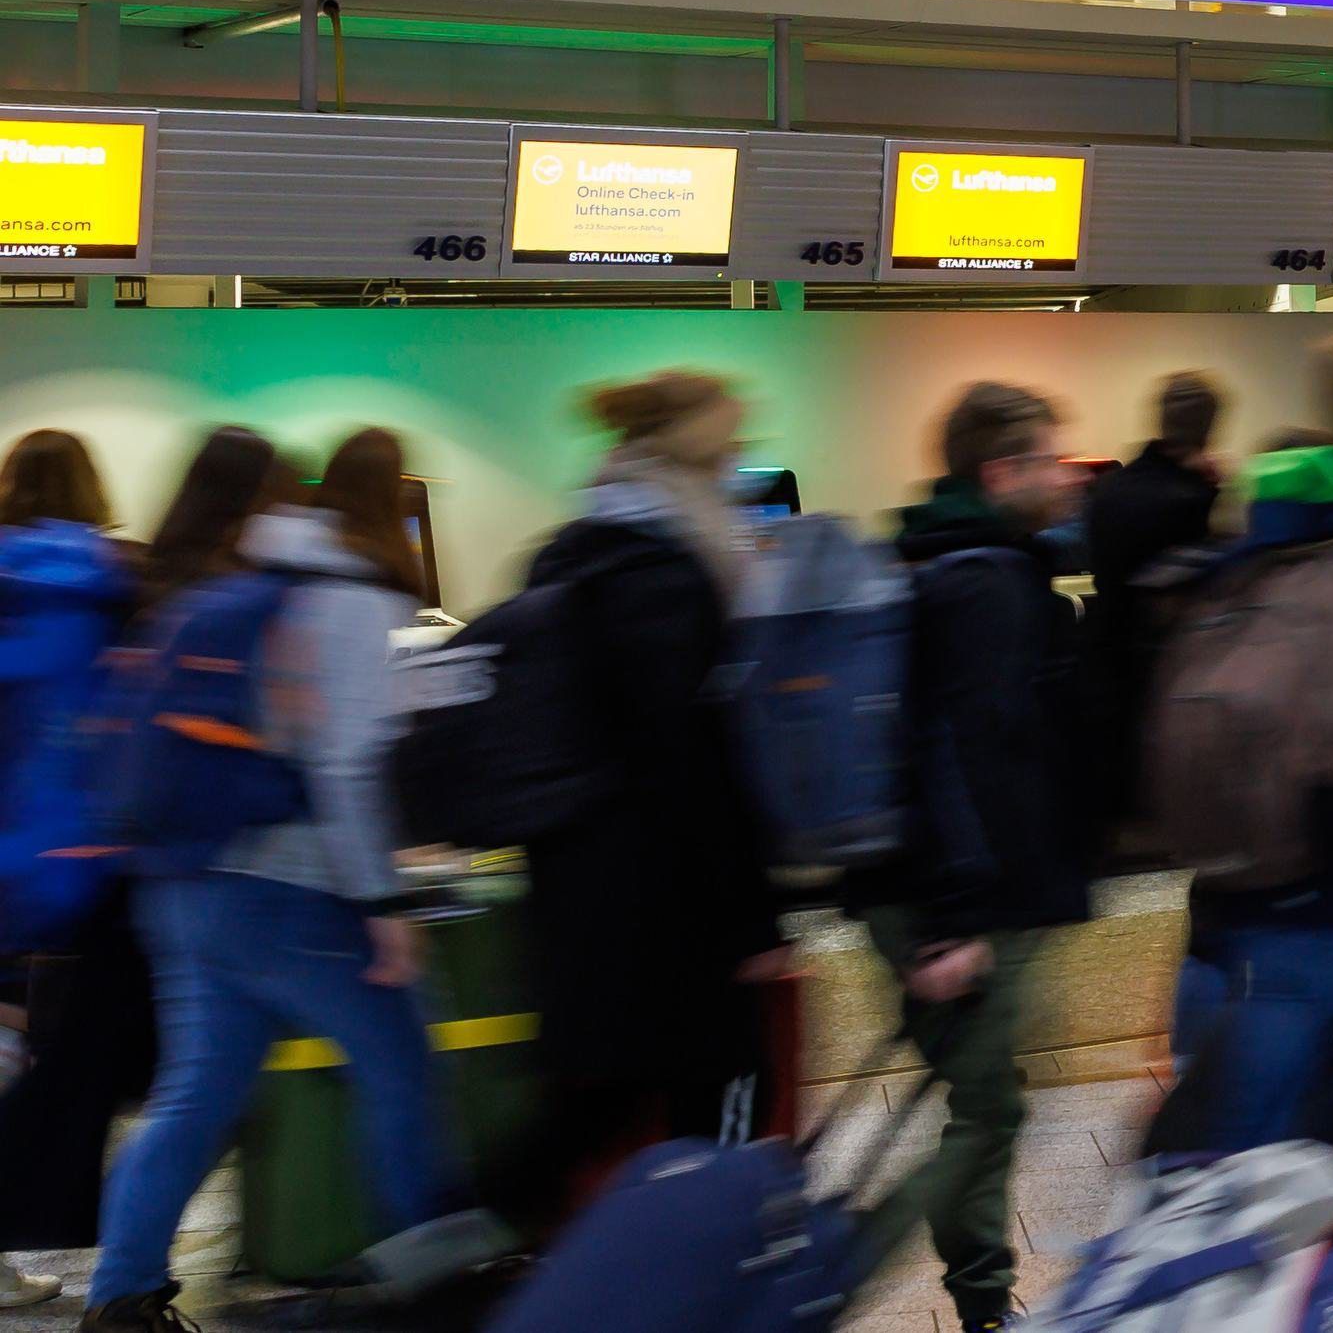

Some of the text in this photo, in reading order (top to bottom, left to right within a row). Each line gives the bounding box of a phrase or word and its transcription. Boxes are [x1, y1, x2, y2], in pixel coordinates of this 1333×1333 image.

[577, 160, 692, 184] Lufthansa
[952, 169, 1056, 192] Lufthansa
[577, 187, 694, 201] Online Check-in
[576, 204, 681, 217] lufthansa.com
[413, 236, 486, 262] 466
[949, 234, 1045, 249] lufthansa.com
[569, 253, 659, 262] STAR ALLIANCE
[802, 240, 864, 266] 465
[1271, 249, 1325, 272] 464
[938, 258, 1021, 270] STAR ALLIANCE
